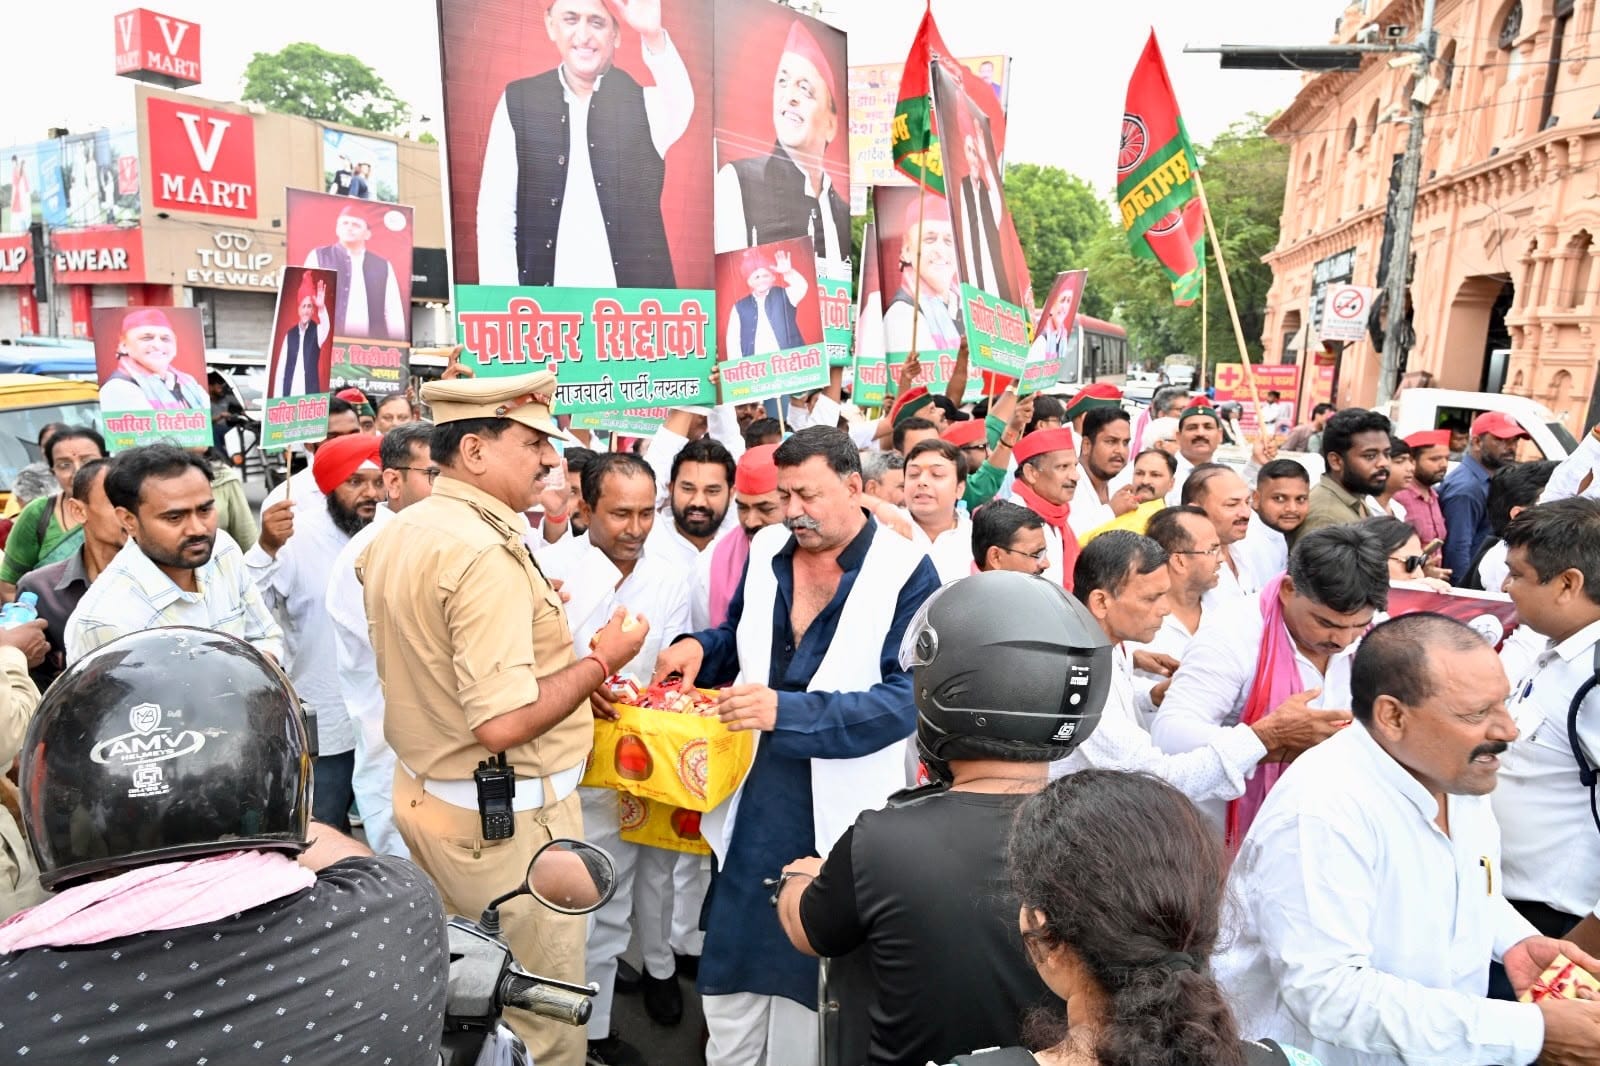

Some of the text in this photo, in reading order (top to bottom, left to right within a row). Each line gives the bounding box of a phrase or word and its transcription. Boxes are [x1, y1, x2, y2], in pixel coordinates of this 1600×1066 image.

[118, 15, 134, 52] V
[155, 15, 190, 57] V
[147, 50, 199, 78] MART
[176, 111, 232, 173] V
[160, 173, 253, 210] MART
[197, 248, 273, 270] TULIP
[592, 299, 709, 362] सिद्दीकी
[554, 376, 614, 406] माजवादी
[108, 732, 186, 758] AMV
[120, 748, 177, 761] HELMETS
